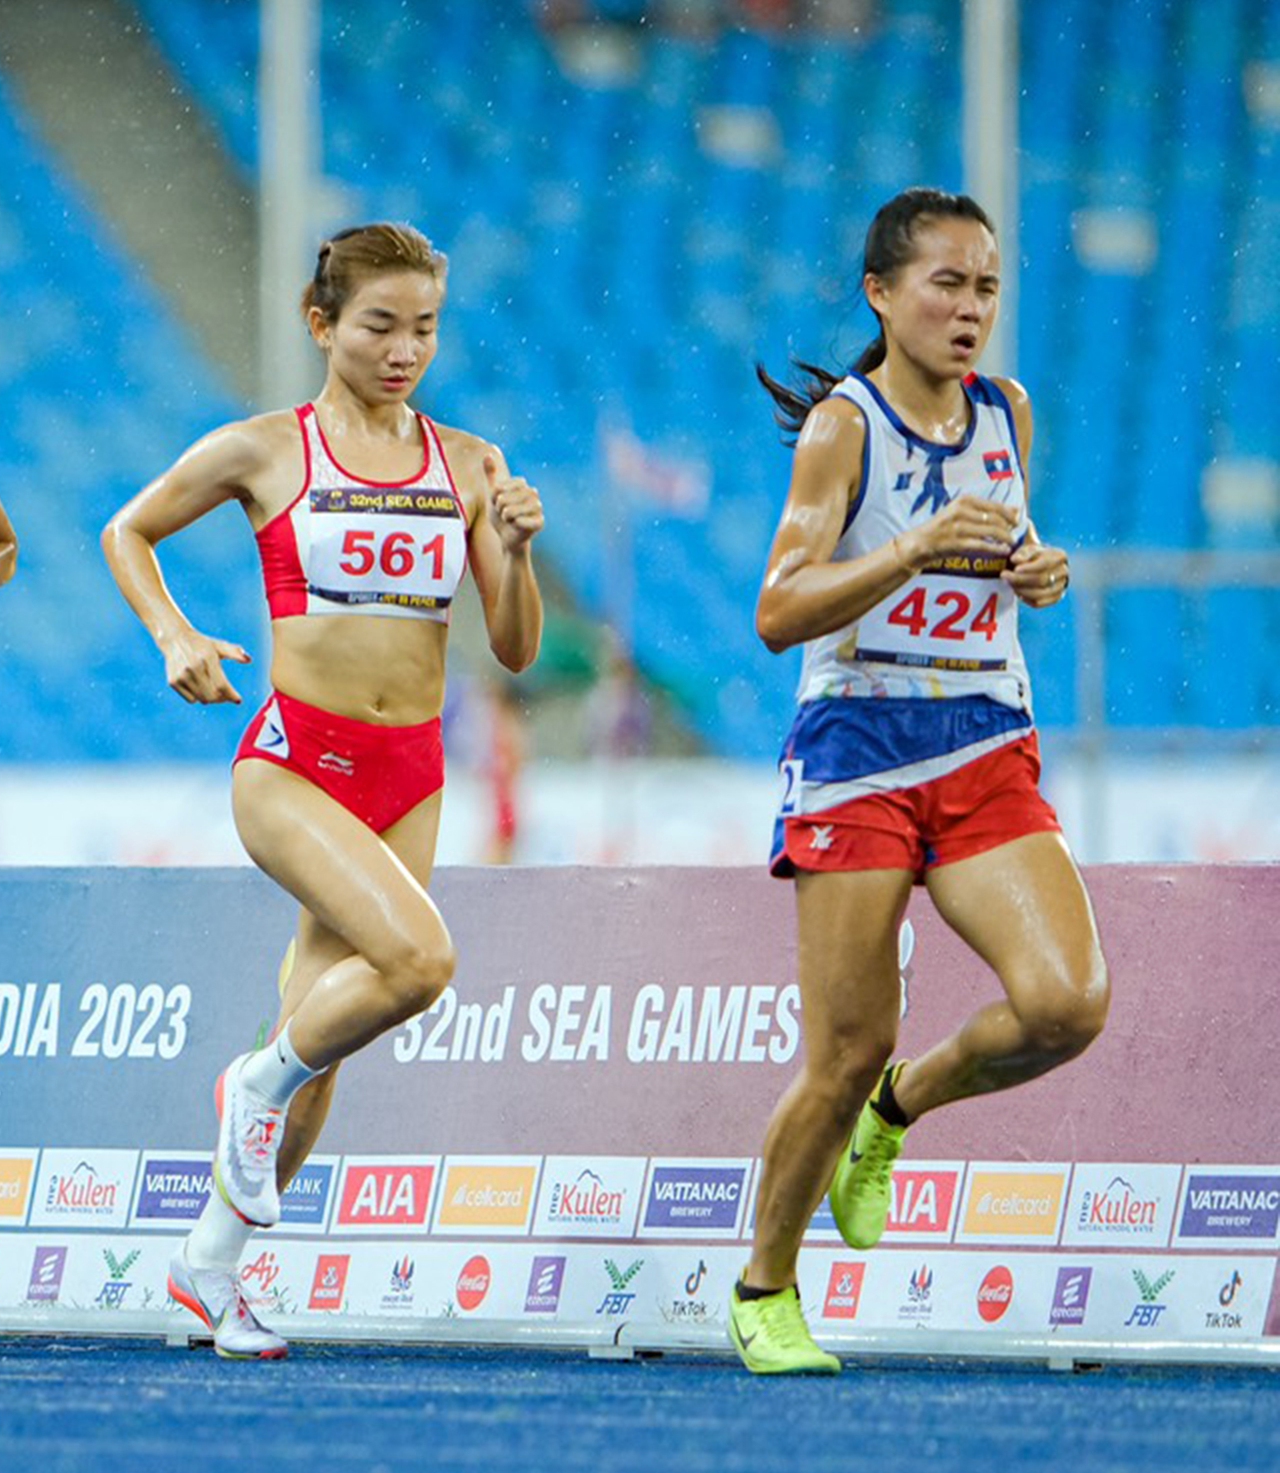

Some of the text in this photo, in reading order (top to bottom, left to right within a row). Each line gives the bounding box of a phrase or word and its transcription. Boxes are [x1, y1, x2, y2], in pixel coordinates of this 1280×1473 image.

[387, 495, 414, 508] SEA
[339, 530, 445, 580] 561
[944, 557, 969, 570] SEA
[887, 586, 998, 642] 424
[71, 984, 192, 1059] 2023
[394, 984, 801, 1063] 32nd SEA GAMES
[56, 1175, 116, 1206] Kulen
[146, 1174, 213, 1193] VATTANA
[654, 1182, 739, 1201] VATTANAC
[350, 1174, 416, 1217] AIA
[465, 1184, 524, 1207] cellcard
[559, 1182, 622, 1215] Kulen
[991, 1192, 1052, 1216] cellcard
[1190, 1190, 1279, 1210] VATTANAC
[670, 1206, 713, 1217] BREWERY
[1090, 1191, 1156, 1224] Kulen
[1206, 1216, 1252, 1226] BREWERY
[95, 1282, 132, 1308] FBT
[596, 1294, 635, 1314] FBT
[672, 1301, 707, 1315] TikTok
[1124, 1305, 1166, 1326] FBT
[1205, 1313, 1242, 1328] TikTok
